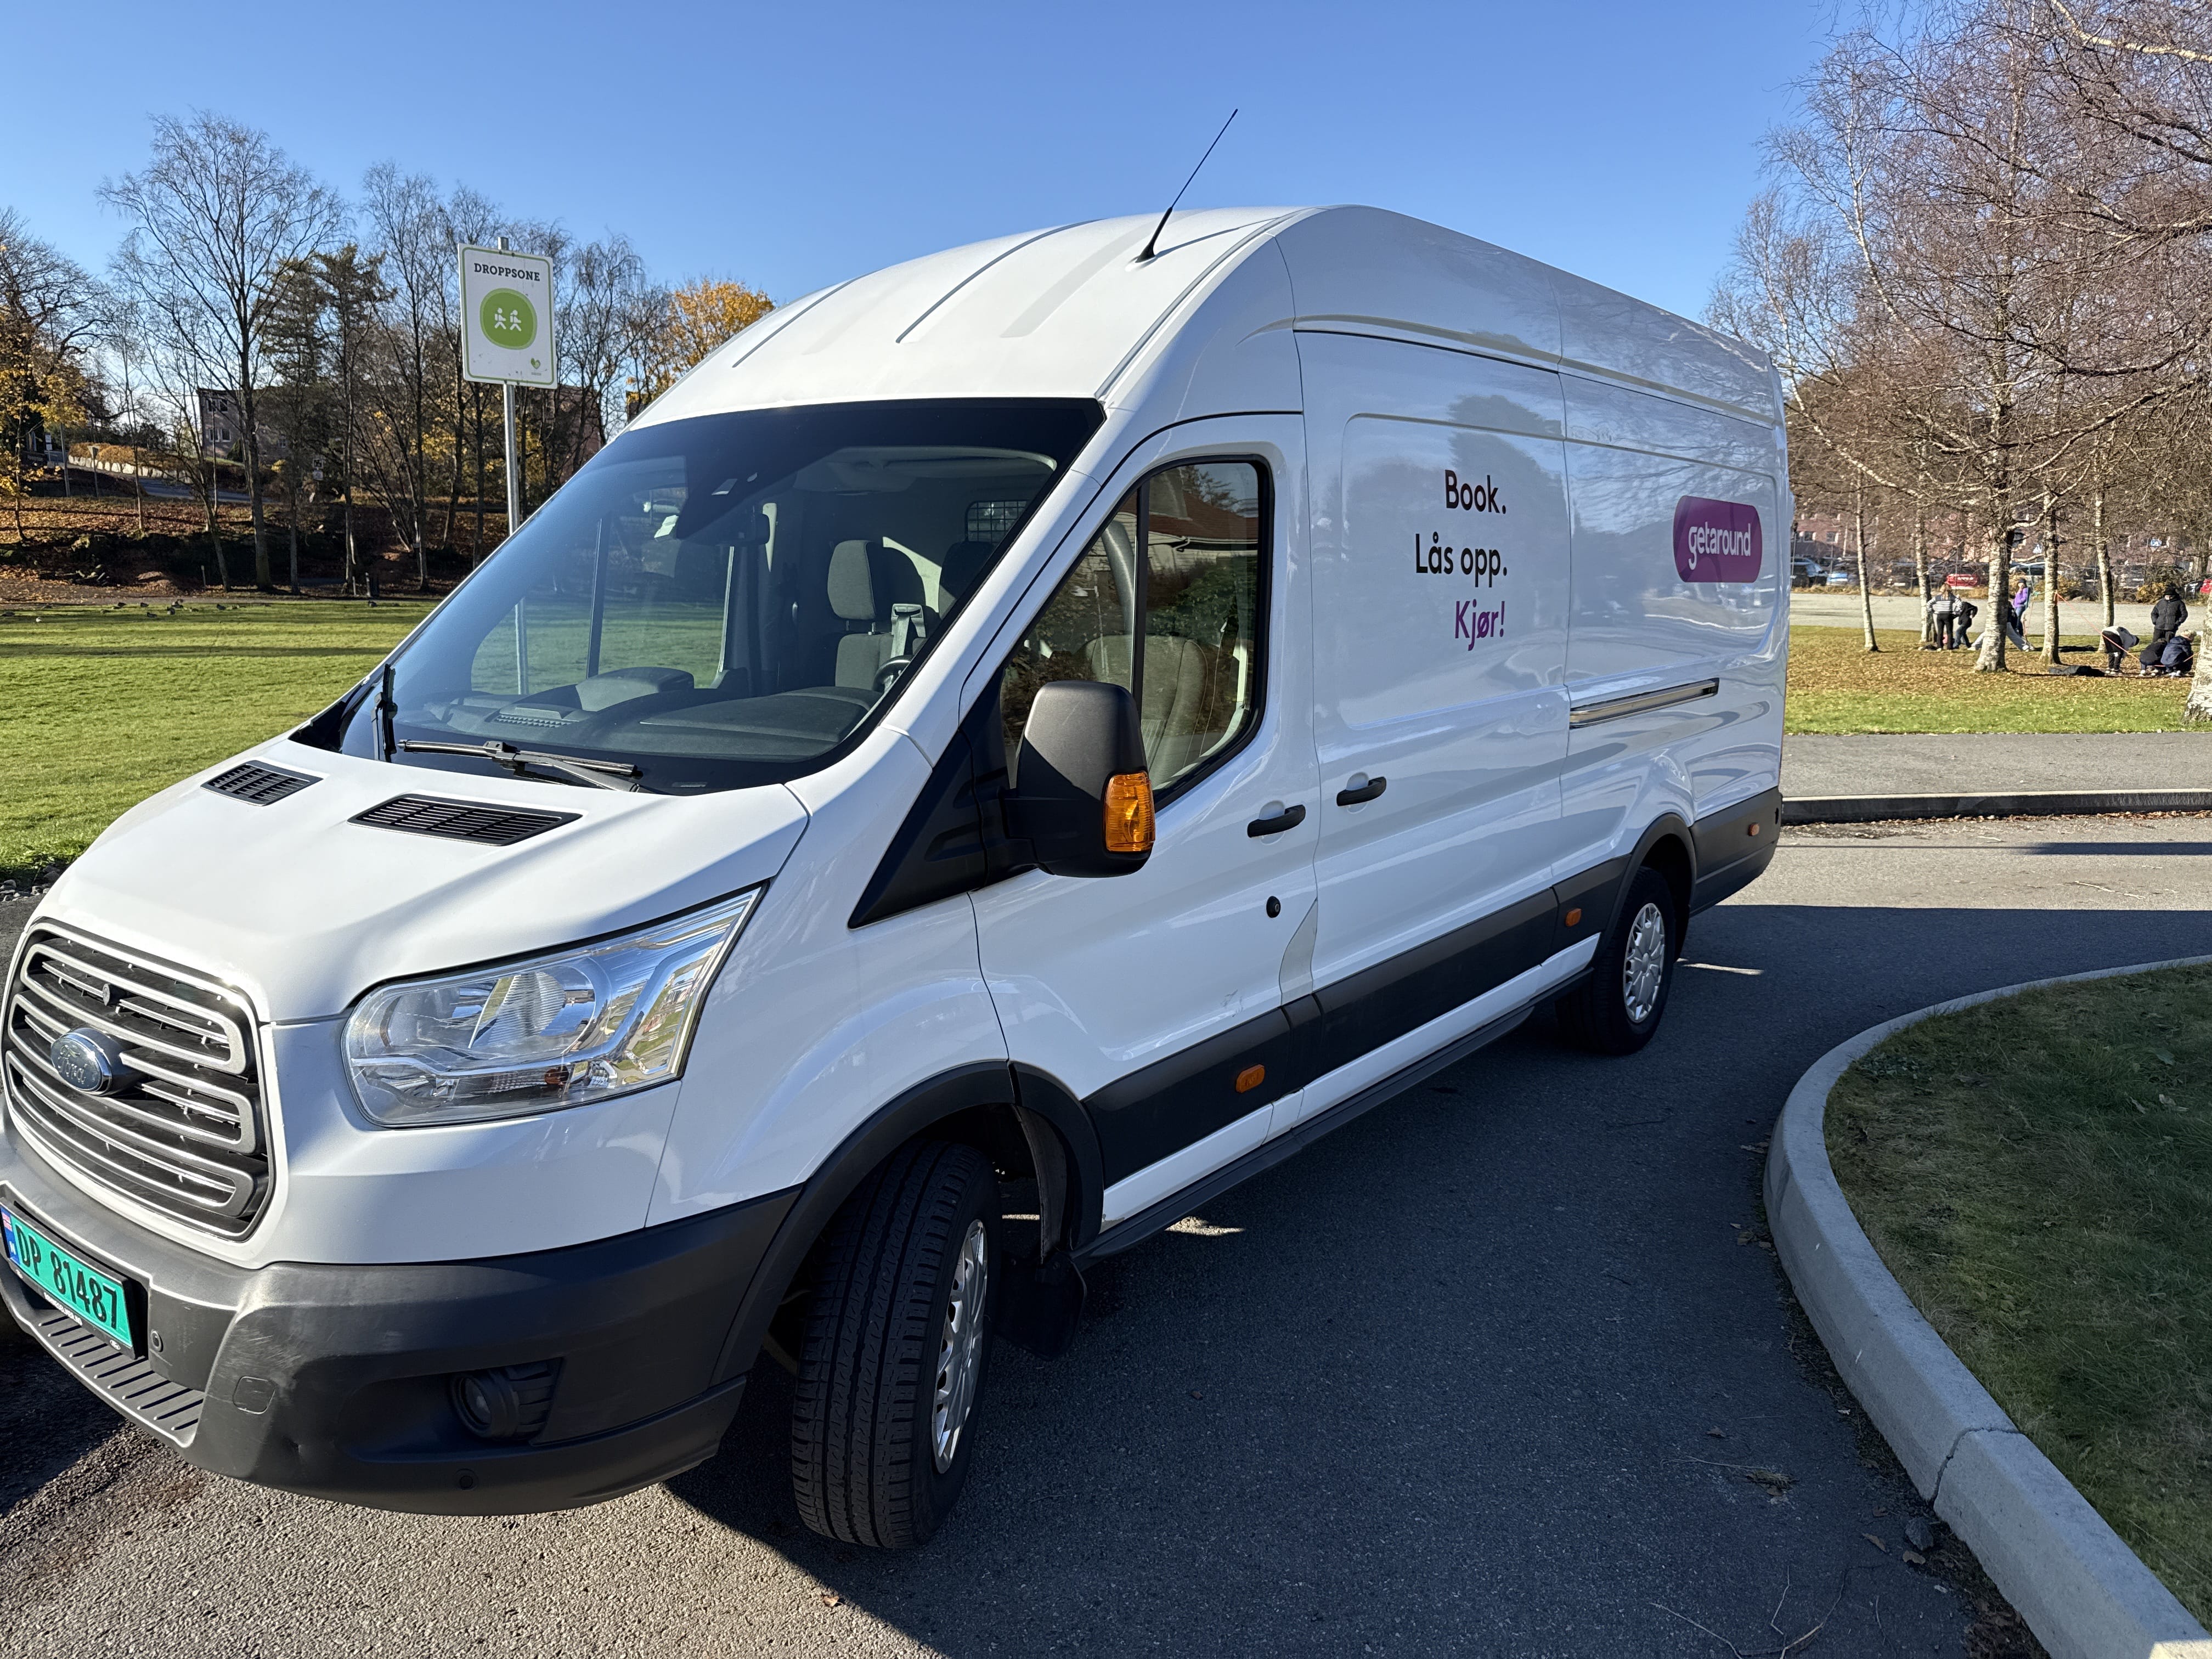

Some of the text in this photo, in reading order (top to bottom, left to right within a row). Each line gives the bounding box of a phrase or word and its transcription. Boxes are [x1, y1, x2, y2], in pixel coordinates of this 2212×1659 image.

[473, 263, 540, 281] DROPPSONE
[1444, 469, 1506, 515] Book.
[1415, 531, 1508, 588] Lås opp.
[1688, 521, 1751, 571] getaround
[1454, 599, 1505, 651] Kjør!
[15, 1224, 42, 1277] DP
[50, 1250, 117, 1330] 81487
